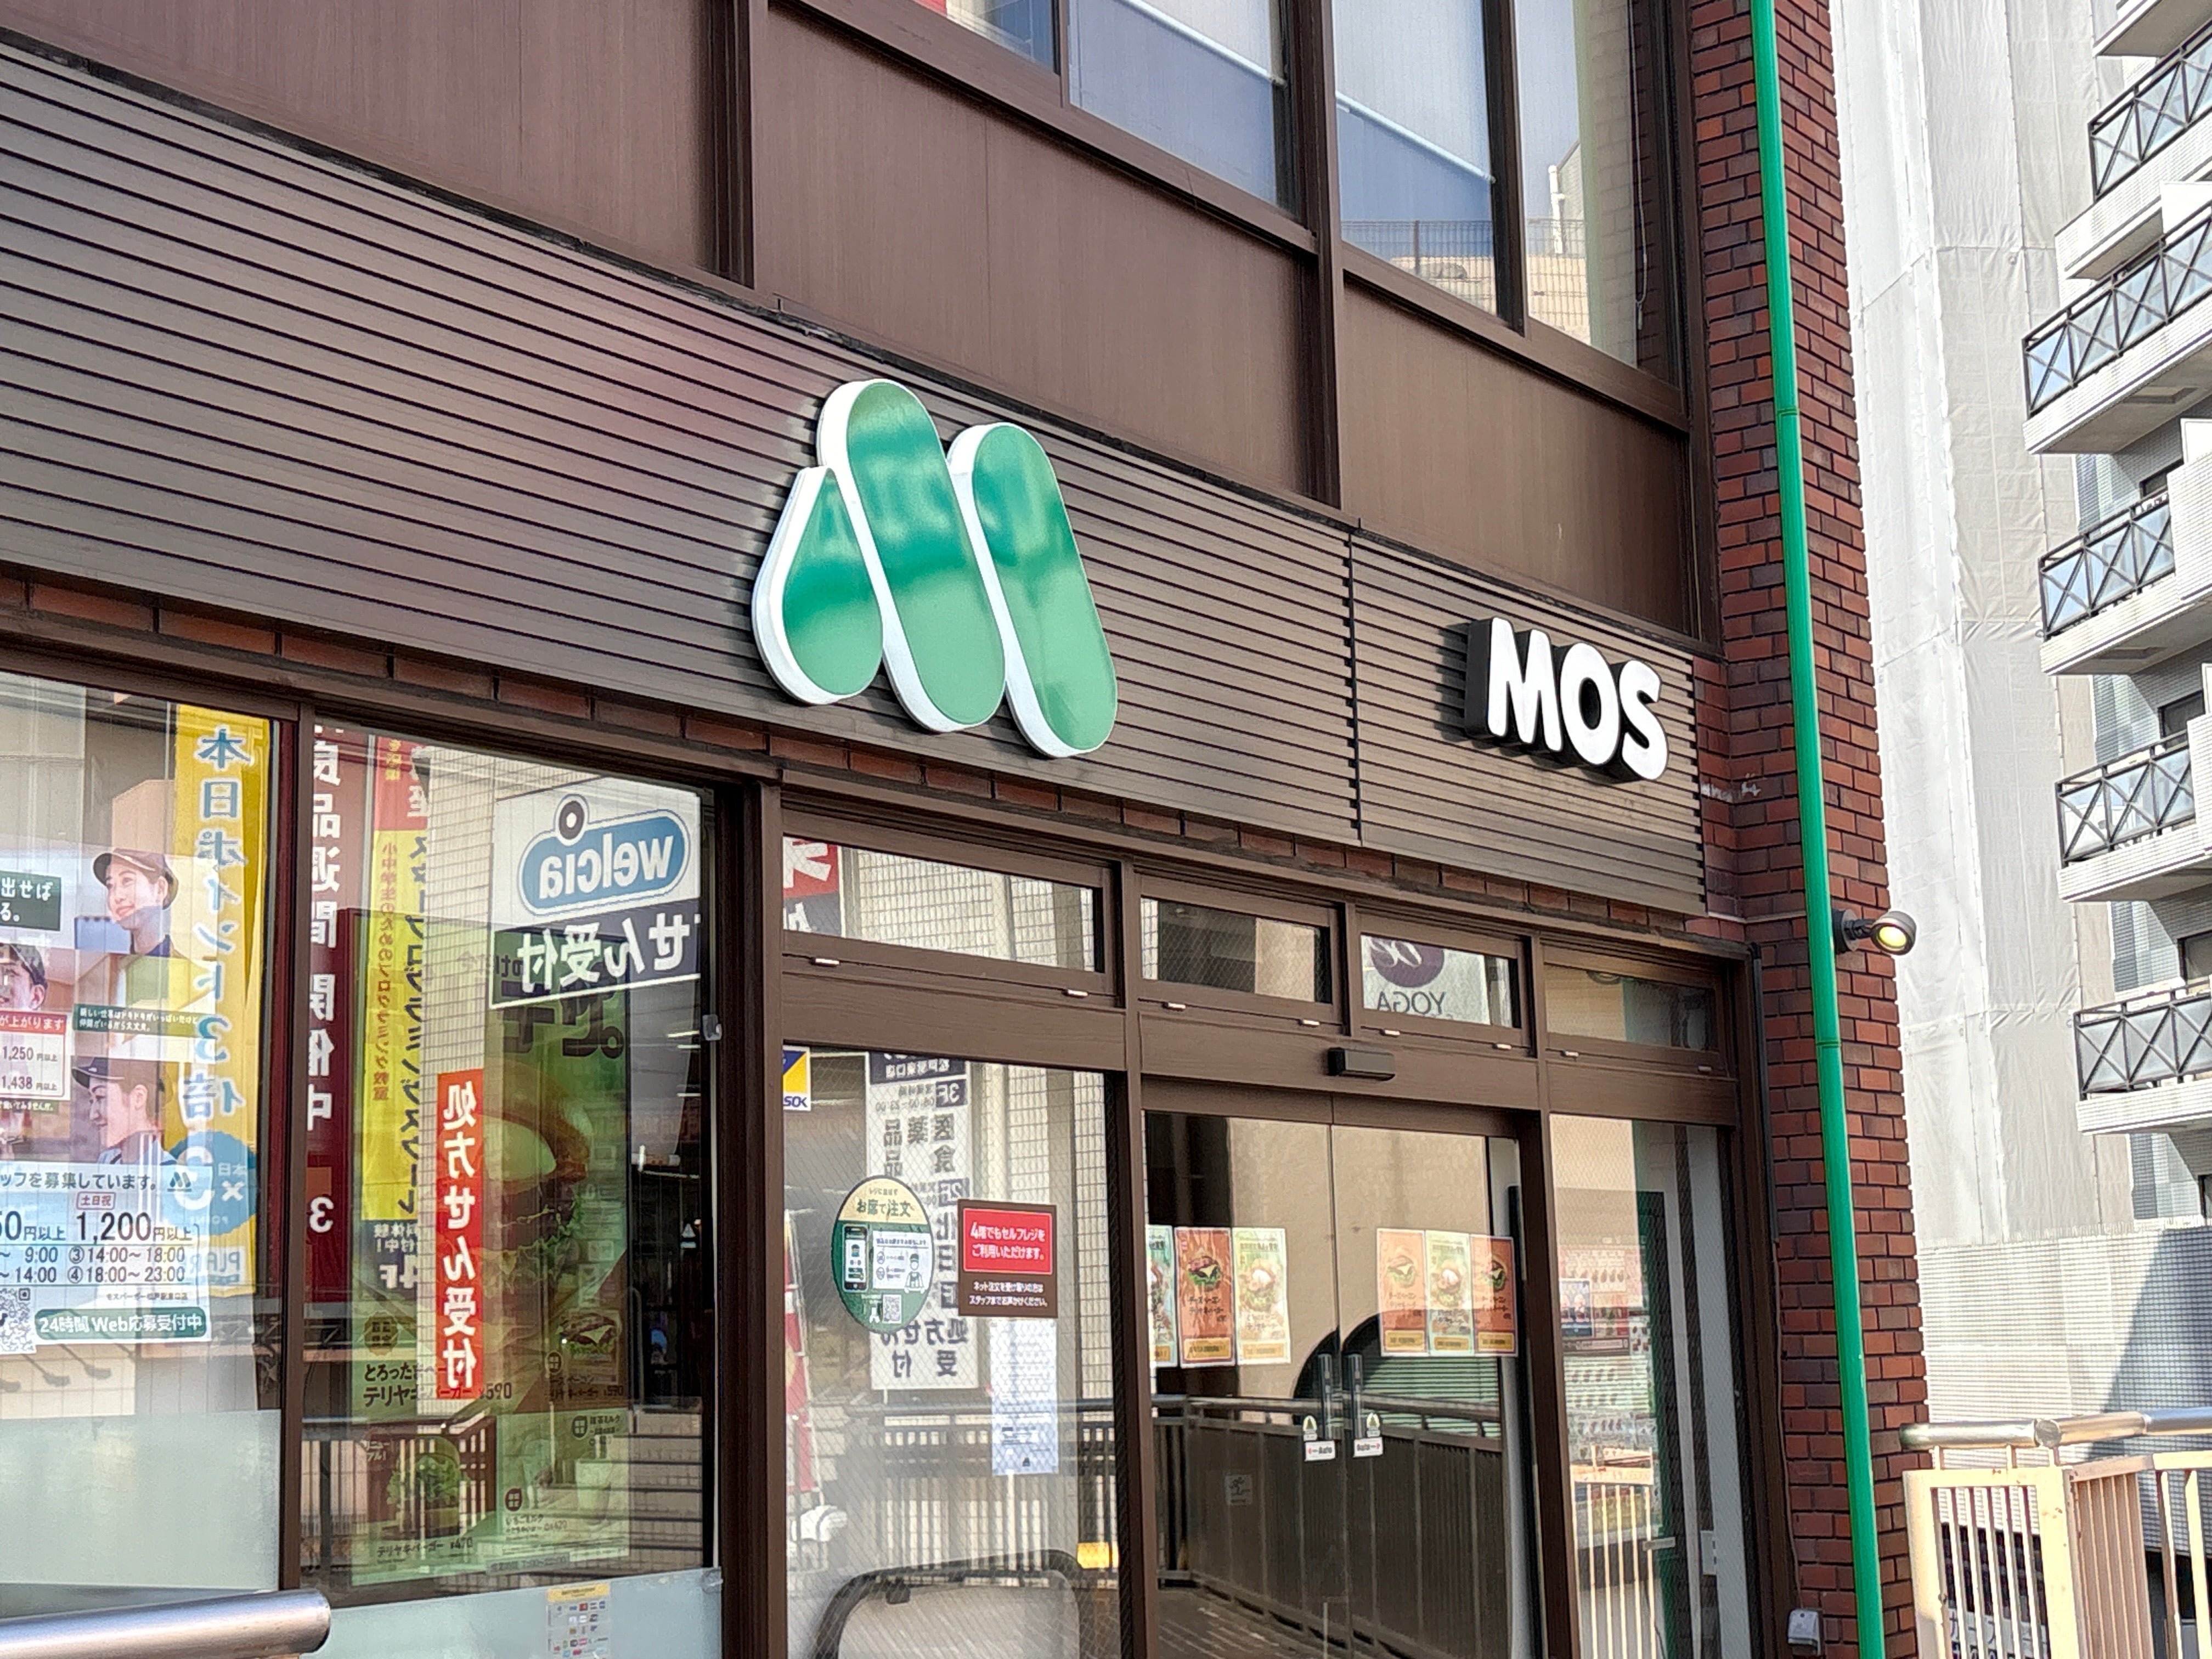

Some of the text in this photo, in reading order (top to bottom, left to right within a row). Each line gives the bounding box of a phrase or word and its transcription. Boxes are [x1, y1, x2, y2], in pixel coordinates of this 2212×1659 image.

[1486, 616, 1669, 781] MOS
[2, 1046, 33, 1062] 1,250
[2, 1075, 32, 1090] 1,438
[0, 1210, 66, 1242] 0円以上
